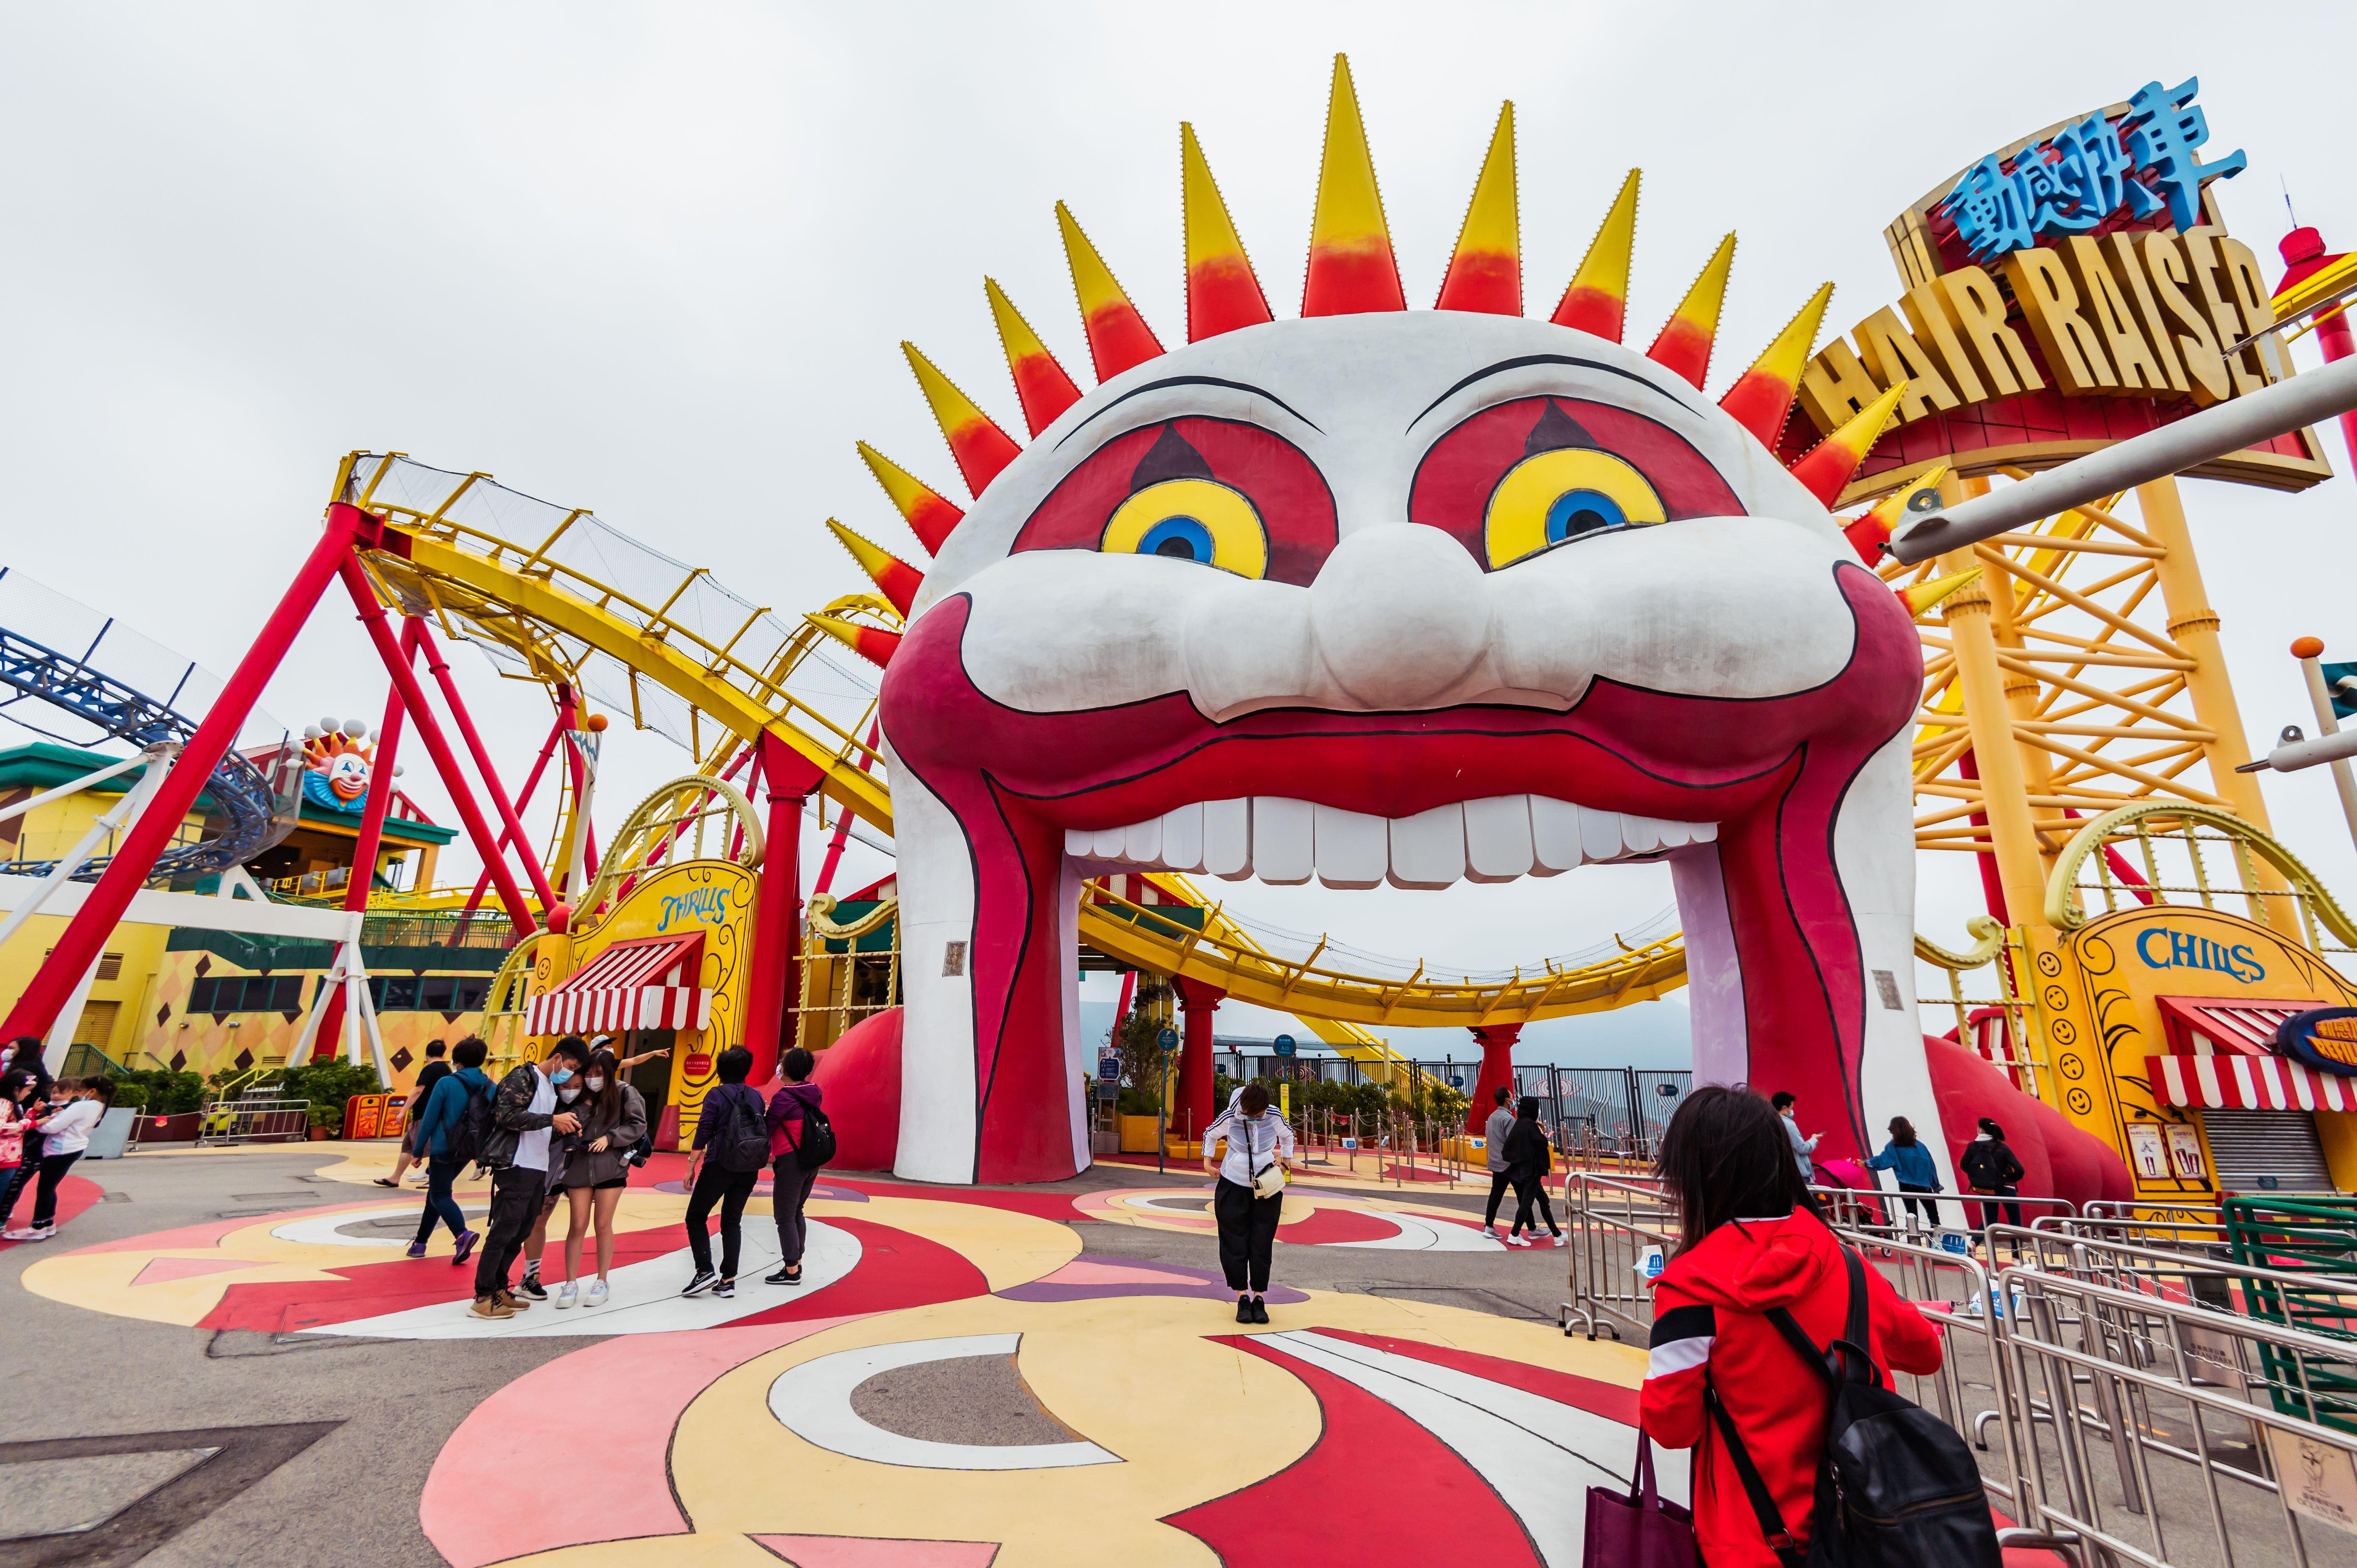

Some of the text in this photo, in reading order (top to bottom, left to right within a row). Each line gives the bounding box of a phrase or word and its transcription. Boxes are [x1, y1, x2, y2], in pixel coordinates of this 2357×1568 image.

[1942, 76, 2246, 263] 動感快車
[1800, 231, 2297, 432] HAIR RAISER
[657, 887, 731, 931] THRILLS
[2136, 927, 2265, 984] CHILLS
[2214, 1355, 2233, 1365] PARK
